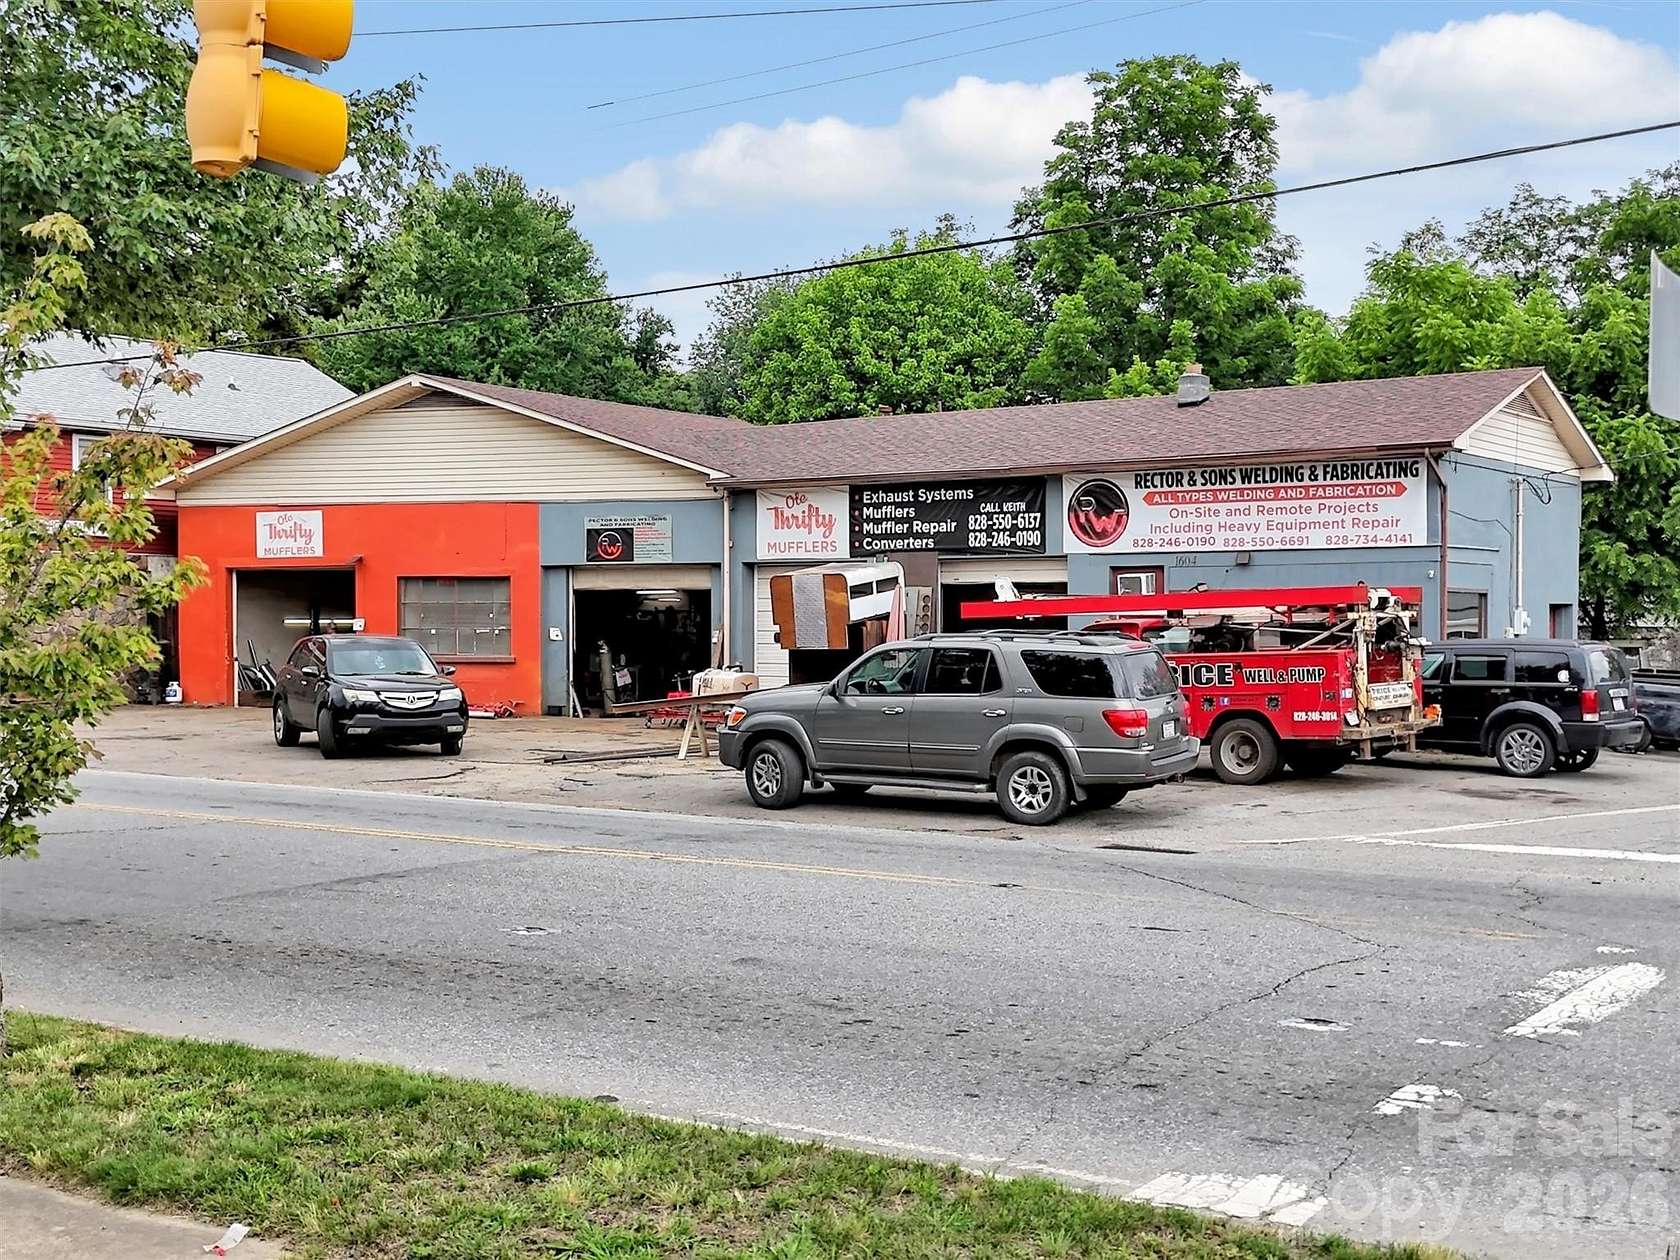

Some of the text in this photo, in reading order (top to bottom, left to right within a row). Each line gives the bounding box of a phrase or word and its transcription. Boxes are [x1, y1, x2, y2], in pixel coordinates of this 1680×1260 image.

[1134, 460, 1419, 489] RECTOR & SONS WELDING & FABRICATING
[863, 488, 974, 504] Exhaust Systems
[1152, 484, 1396, 504] ALL TYPES WELDING AND FABRICATION
[862, 505, 916, 519] Mufflers
[980, 502, 1026, 513] CALL KEITH
[1169, 501, 1378, 519] On-Site and Remote Projects
[766, 503, 836, 539] Thrifty
[862, 519, 957, 535] Muffler Repair
[968, 512, 1041, 530] 828-550-6137
[1150, 516, 1401, 535] Including Heavy Equipment Repair
[263, 520, 315, 546] Thrifty
[968, 530, 1041, 547] 828-246-0190
[1132, 533, 1413, 548] 828-246-0190 828-550-6691 828-734-4141
[264, 546, 316, 556] MUFFLERS
[767, 540, 838, 554] MUFFLERS
[862, 536, 935, 550] Converters
[1175, 555, 1198, 566] 1604
[1243, 668, 1276, 684] WELL
[1277, 670, 1288, 683] &
[1289, 667, 1326, 683] PUMP
